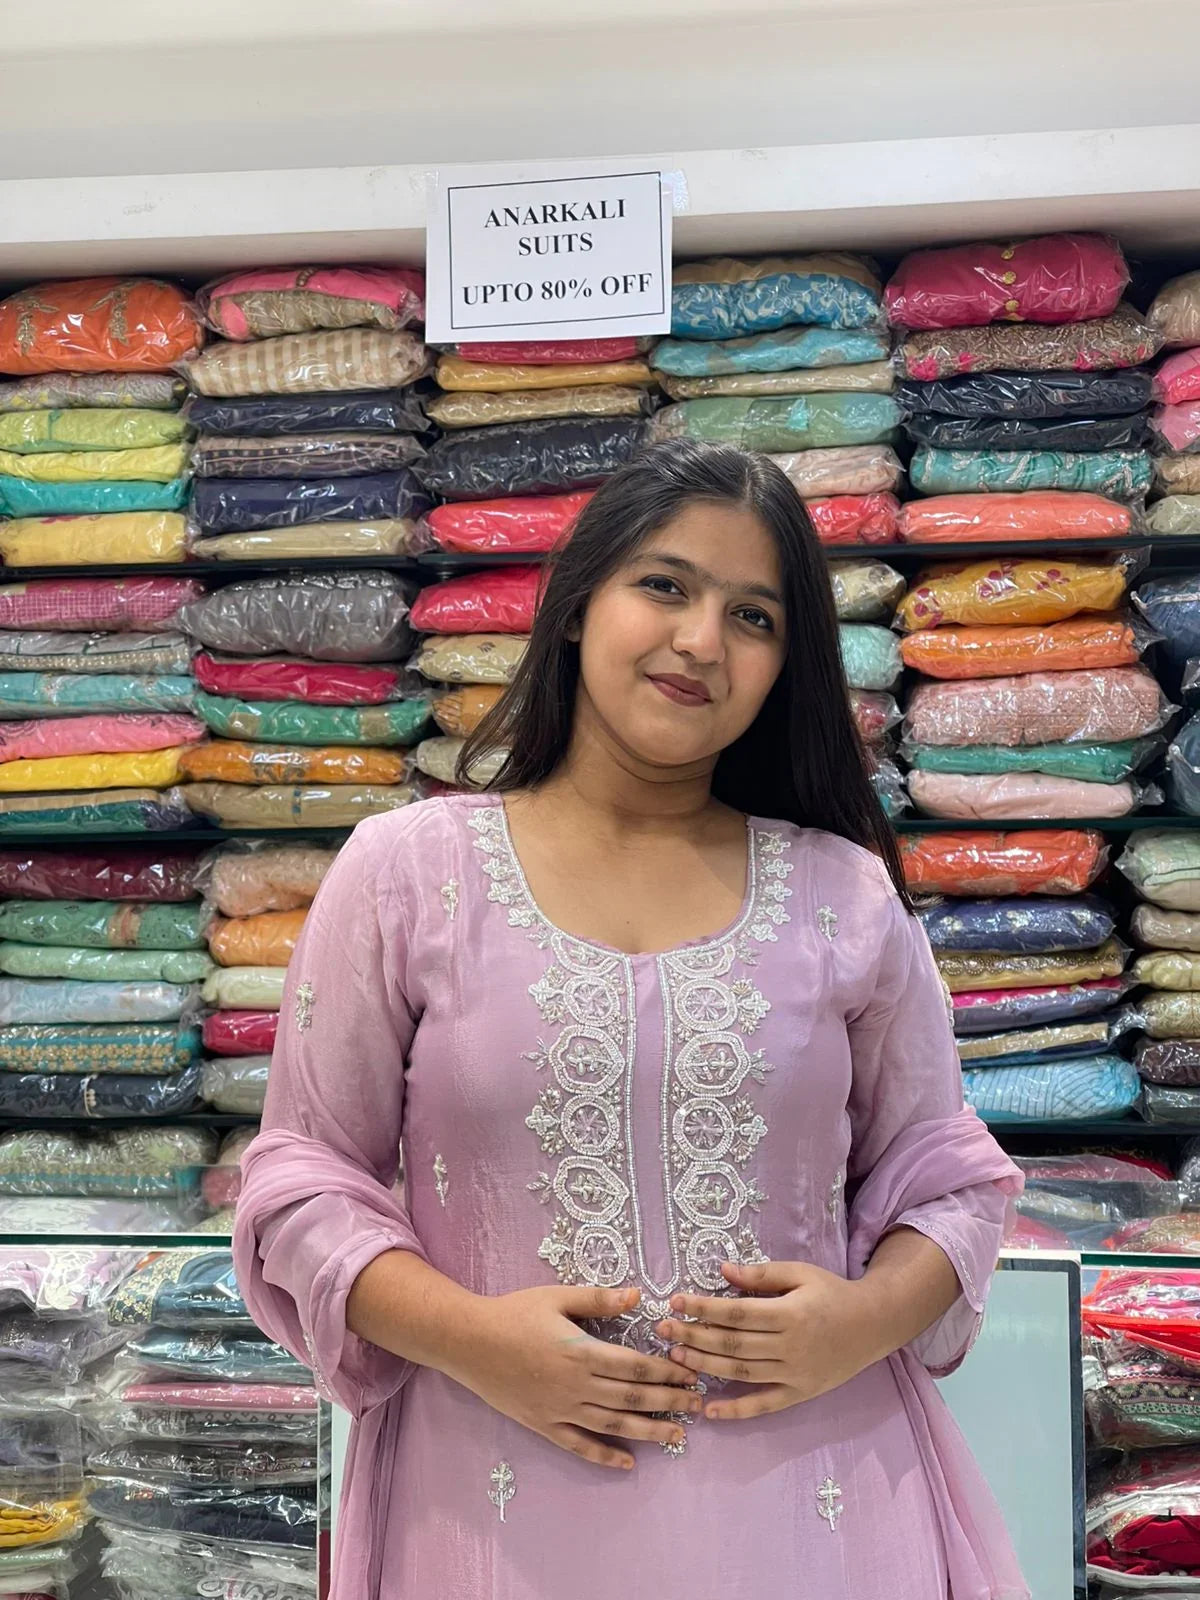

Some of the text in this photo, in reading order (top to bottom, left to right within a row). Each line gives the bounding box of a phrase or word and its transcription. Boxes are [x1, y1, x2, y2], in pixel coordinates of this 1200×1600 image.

[484, 199, 626, 228] ANARKALI
[518, 232, 593, 257] SUITS
[462, 273, 653, 306] UPTO 80% OFF
